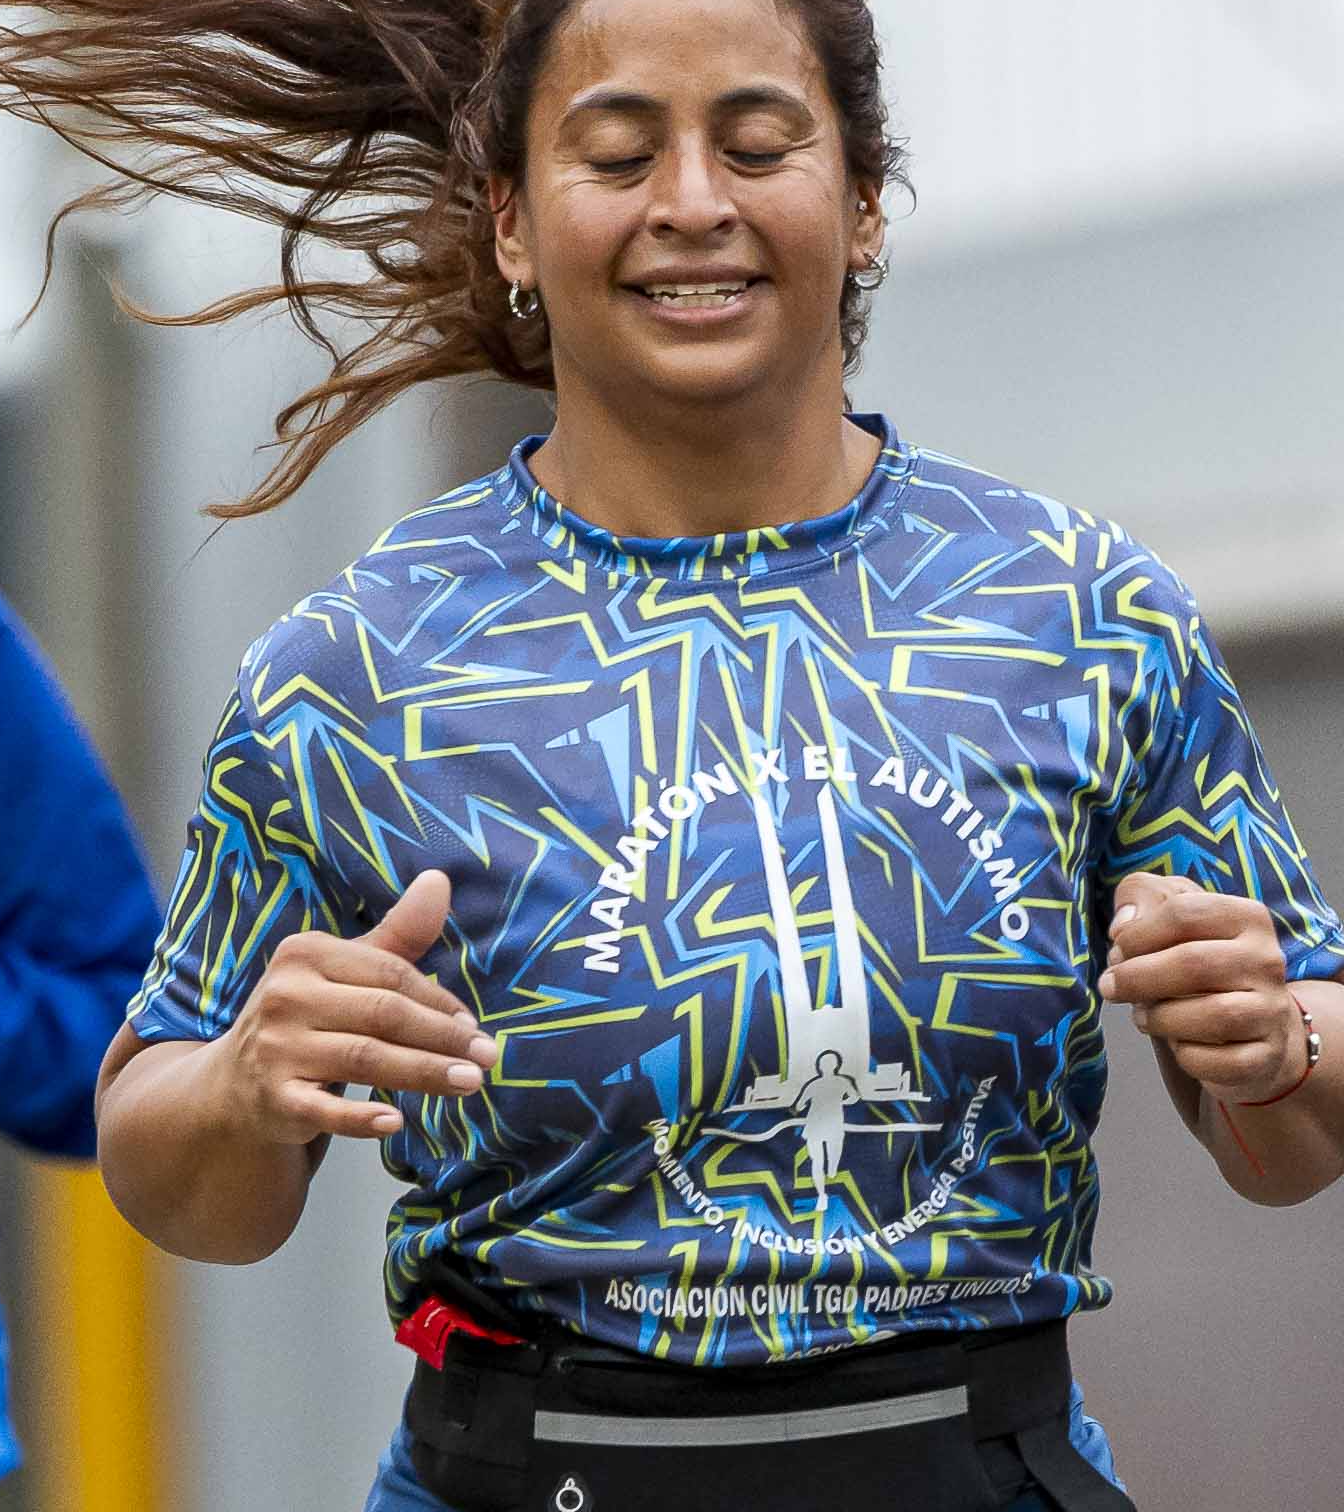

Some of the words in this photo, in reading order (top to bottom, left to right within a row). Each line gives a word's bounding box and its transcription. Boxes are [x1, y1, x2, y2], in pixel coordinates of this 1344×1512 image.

[583, 761, 739, 973] MARATÓN
[751, 749, 790, 785] X
[802, 745, 857, 783] EL
[870, 756, 1030, 941] AUTISMO
[881, 1171, 958, 1246] ENERGÍA
[949, 1074, 999, 1174] POSITIVA
[751, 1284, 809, 1317] CIVIL
[813, 1284, 858, 1314] TGD
[862, 1283, 946, 1312] PADRES
[949, 1272, 1034, 1300] UNIDOS
